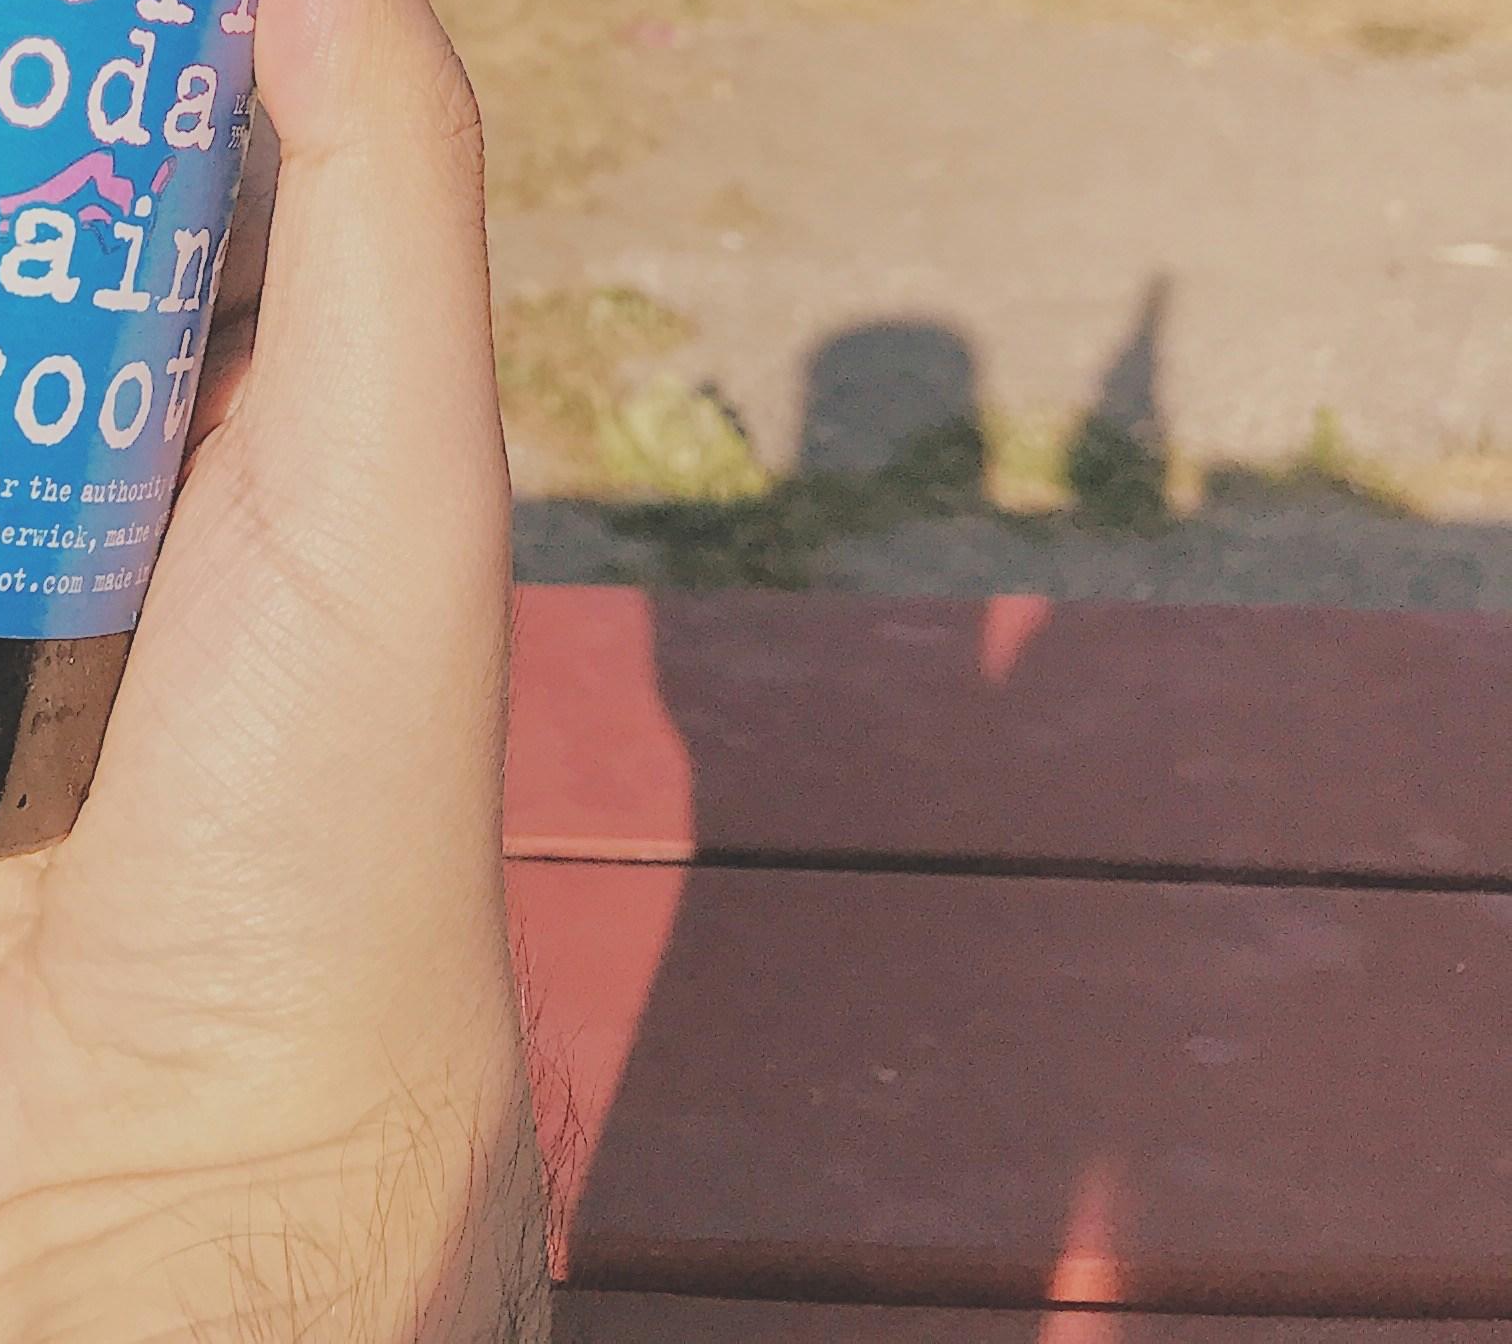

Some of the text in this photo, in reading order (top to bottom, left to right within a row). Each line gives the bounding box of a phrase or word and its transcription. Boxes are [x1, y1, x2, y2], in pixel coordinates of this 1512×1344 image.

[29, 475, 72, 503] the
[103, 521, 150, 548] maine
[92, 566, 133, 593] made
